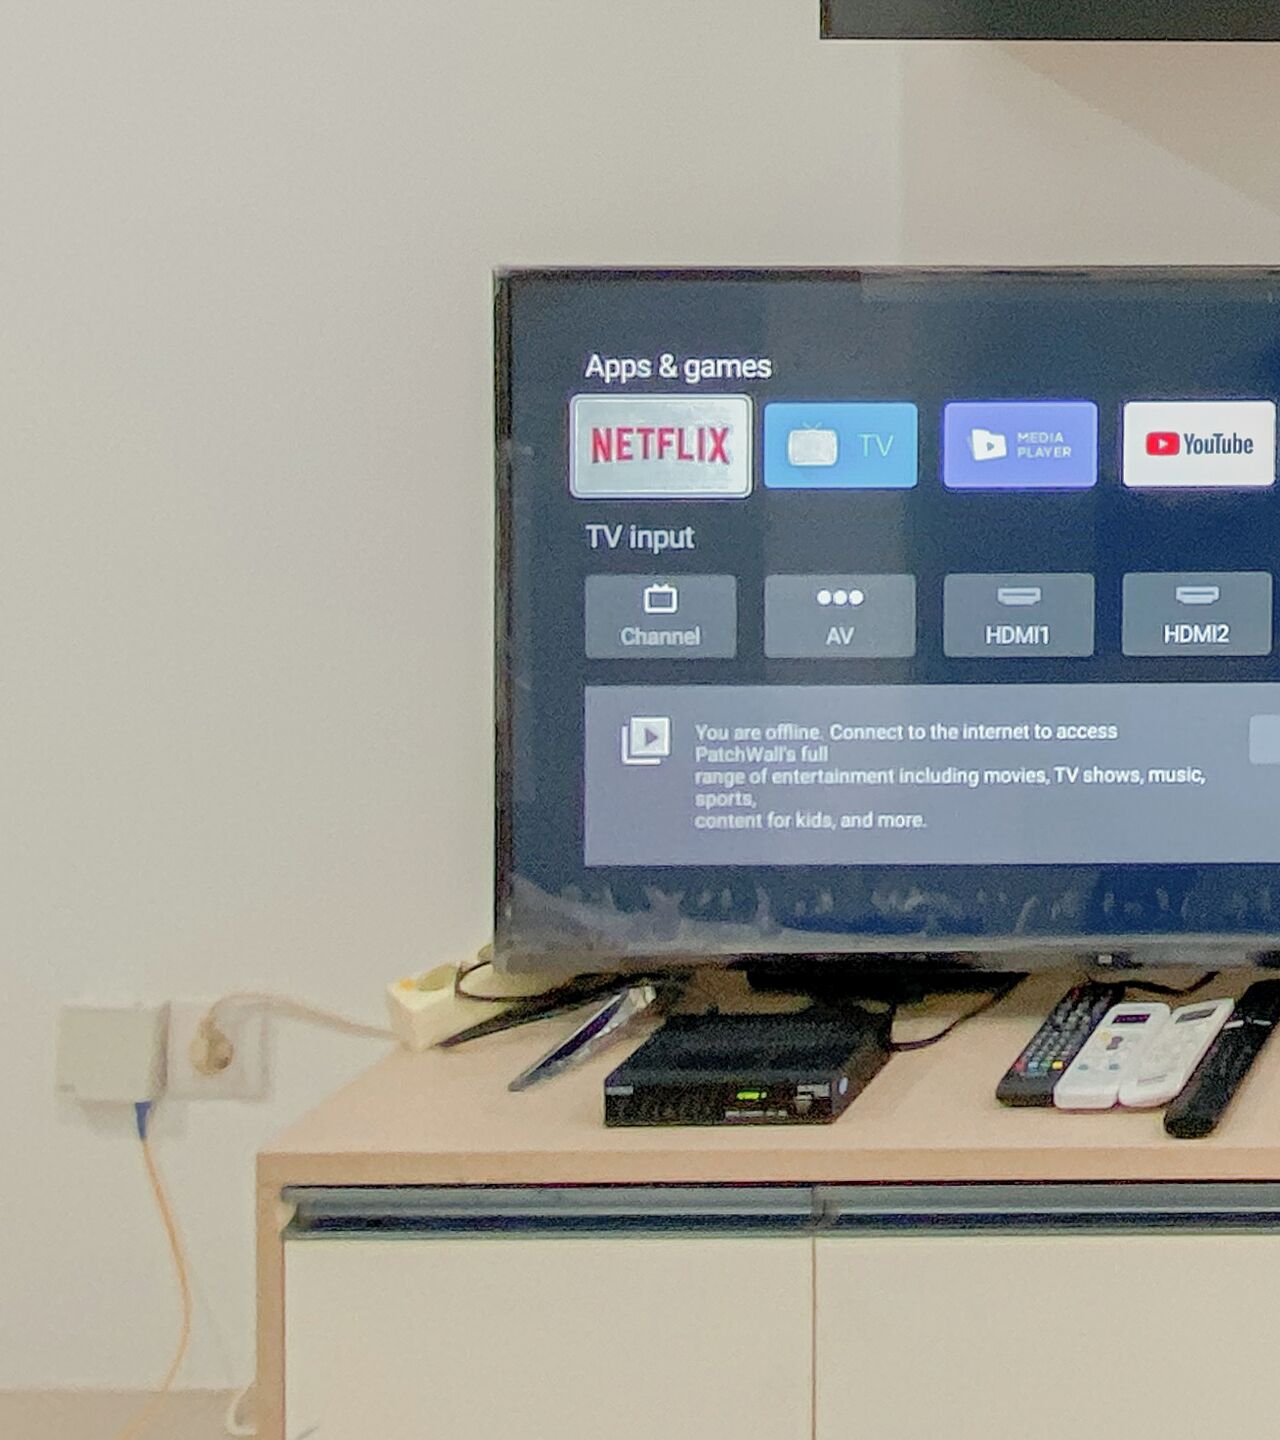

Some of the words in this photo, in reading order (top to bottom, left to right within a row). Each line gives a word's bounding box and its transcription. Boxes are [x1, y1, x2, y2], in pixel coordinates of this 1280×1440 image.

[585, 355, 652, 381] Apps
[658, 355, 678, 377] &
[685, 359, 772, 382] games
[591, 427, 729, 465] NETFLIX
[861, 434, 894, 456] TV
[1017, 432, 1064, 444] MEDIA
[1184, 433, 1254, 455] YouTube
[1017, 446, 1072, 458] PLAYER
[586, 526, 623, 548] TV
[629, 525, 695, 552] input
[620, 627, 700, 646] Channel
[826, 627, 854, 645] AV
[986, 625, 1050, 645] HDMI1
[1164, 626, 1229, 643] HDMI2
[695, 724, 730, 741] You
[734, 728, 761, 741] are
[766, 724, 824, 741] offline.
[830, 723, 902, 741] Connect
[908, 725, 926, 740] to
[930, 723, 958, 740] the
[963, 723, 1030, 740] internet
[1034, 725, 1052, 740] to
[1057, 726, 1118, 740] access
[695, 746, 796, 763] PatchWall's
[801, 745, 828, 763] full
[695, 771, 746, 788] range
[750, 768, 768, 785] of
[772, 768, 894, 785] entertainment
[900, 768, 979, 787] including
[984, 768, 1050, 787] movies,
[1055, 766, 1079, 784] TV
[1083, 767, 1145, 787] shows,
[1149, 767, 1205, 786] music,
[695, 792, 756, 810] sports,
[695, 813, 762, 829] content
[767, 812, 791, 829] for
[796, 812, 836, 831] kids,
[841, 812, 873, 829] and
[878, 815, 926, 829] more.
